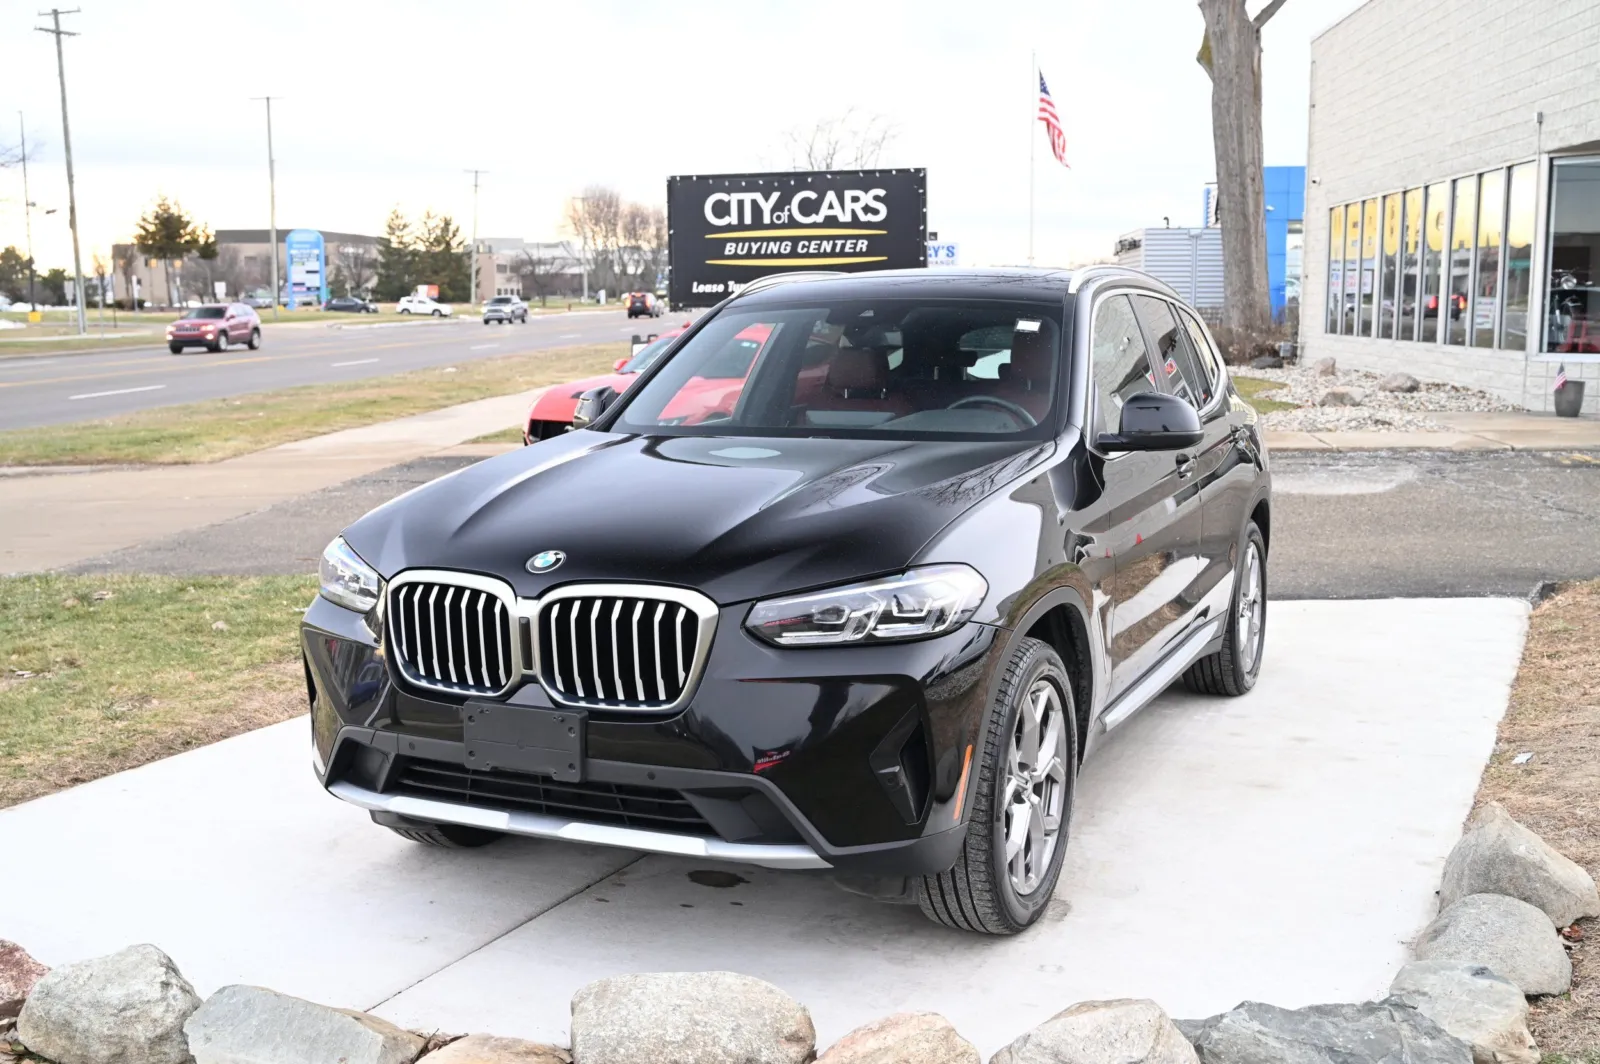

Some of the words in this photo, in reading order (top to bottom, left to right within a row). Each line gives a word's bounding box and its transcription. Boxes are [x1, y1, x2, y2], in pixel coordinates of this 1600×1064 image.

[704, 192, 781, 226] CITY
[773, 205, 791, 224] of
[791, 188, 888, 224] CARS
[724, 240, 792, 255] BUYING
[797, 239, 868, 253] CENTER
[692, 281, 725, 293] Lease
